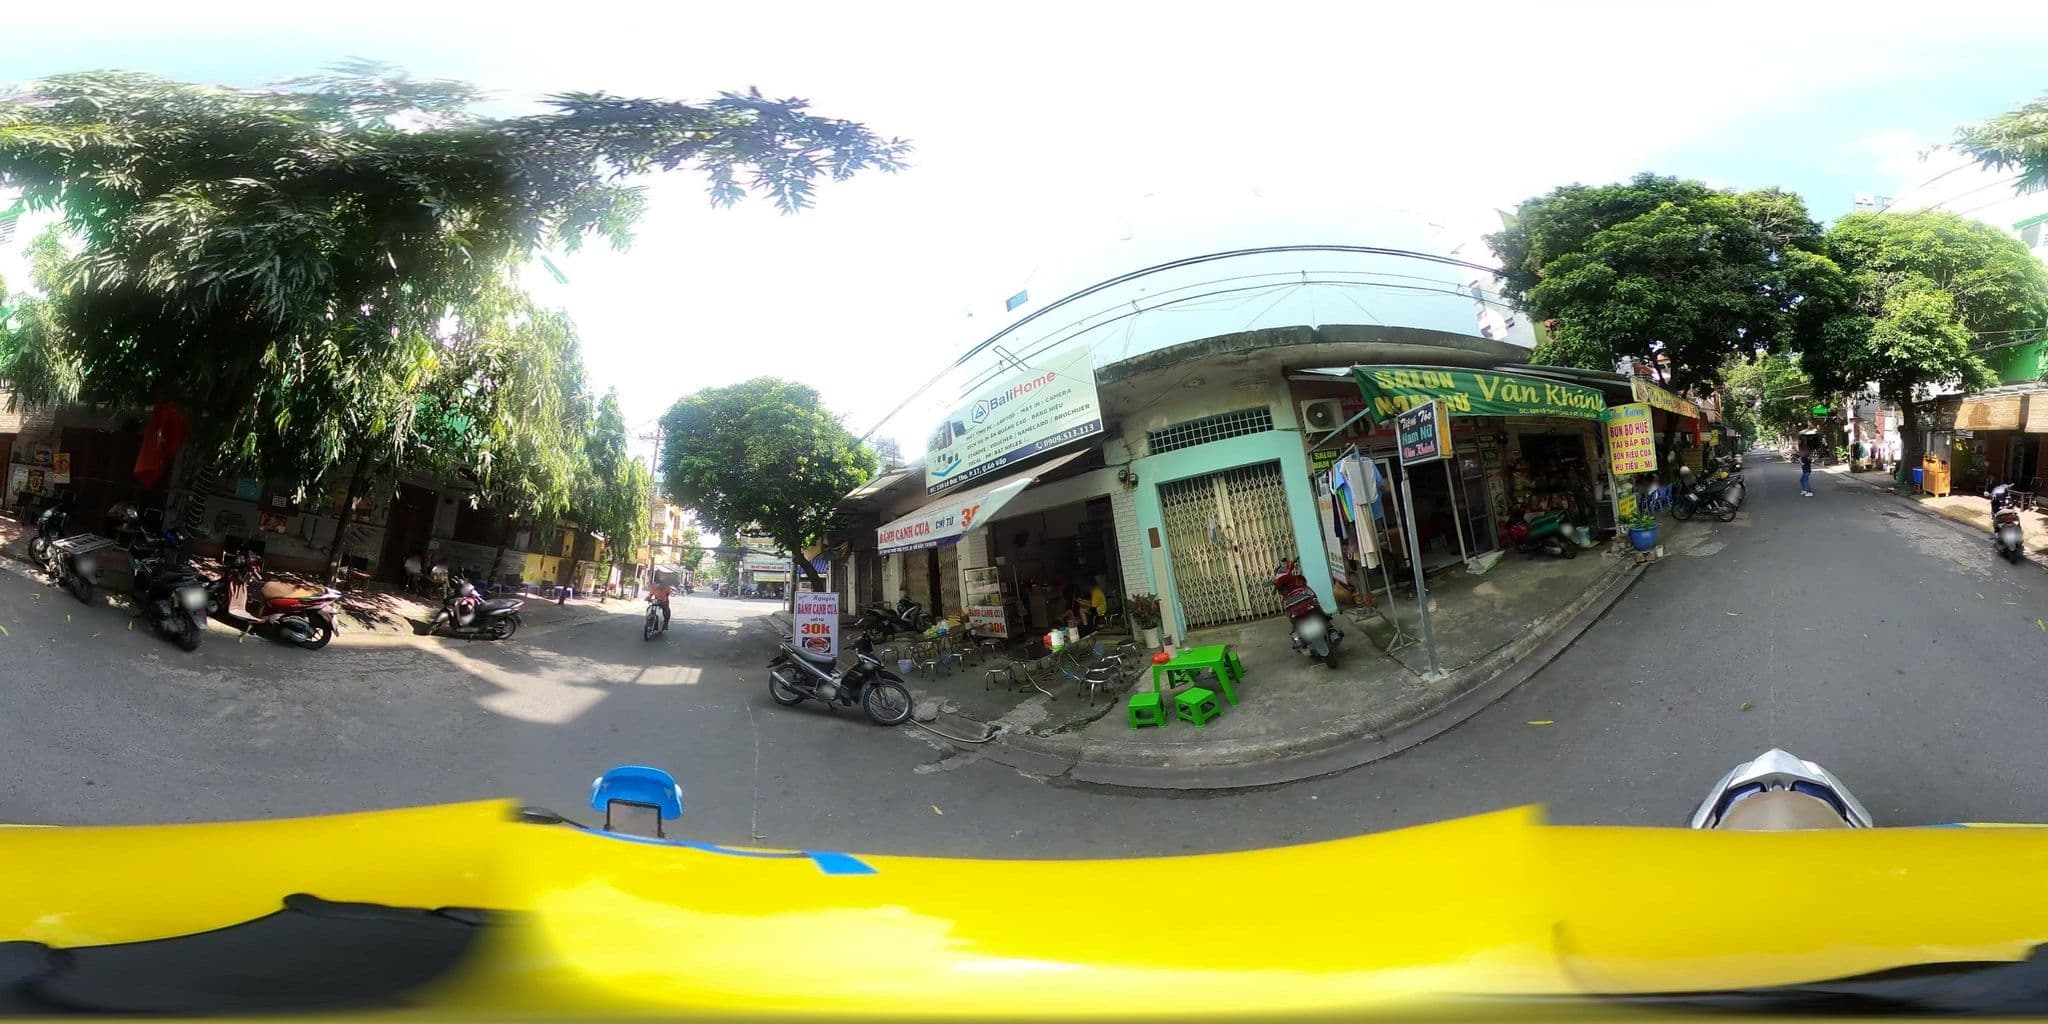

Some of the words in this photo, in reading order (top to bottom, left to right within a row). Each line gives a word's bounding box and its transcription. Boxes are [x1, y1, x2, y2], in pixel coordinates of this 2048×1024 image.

[1374, 369, 1455, 389] SALON
[990, 371, 1056, 411] BaliHome
[1045, 388, 1072, 402] CAMERA
[1473, 374, 1540, 403] Vân
[1545, 383, 1607, 413] Khánh
[1017, 419, 1049, 436] NAMECARD
[1043, 423, 1094, 447] 0909.513.113
[1314, 450, 1337, 460] SALON
[879, 529, 895, 545] BÁNH
[895, 525, 913, 540] CANH
[914, 521, 930, 537] CUA
[812, 603, 827, 615] CANH
[827, 604, 838, 615] CUA
[801, 623, 831, 635] 30k
